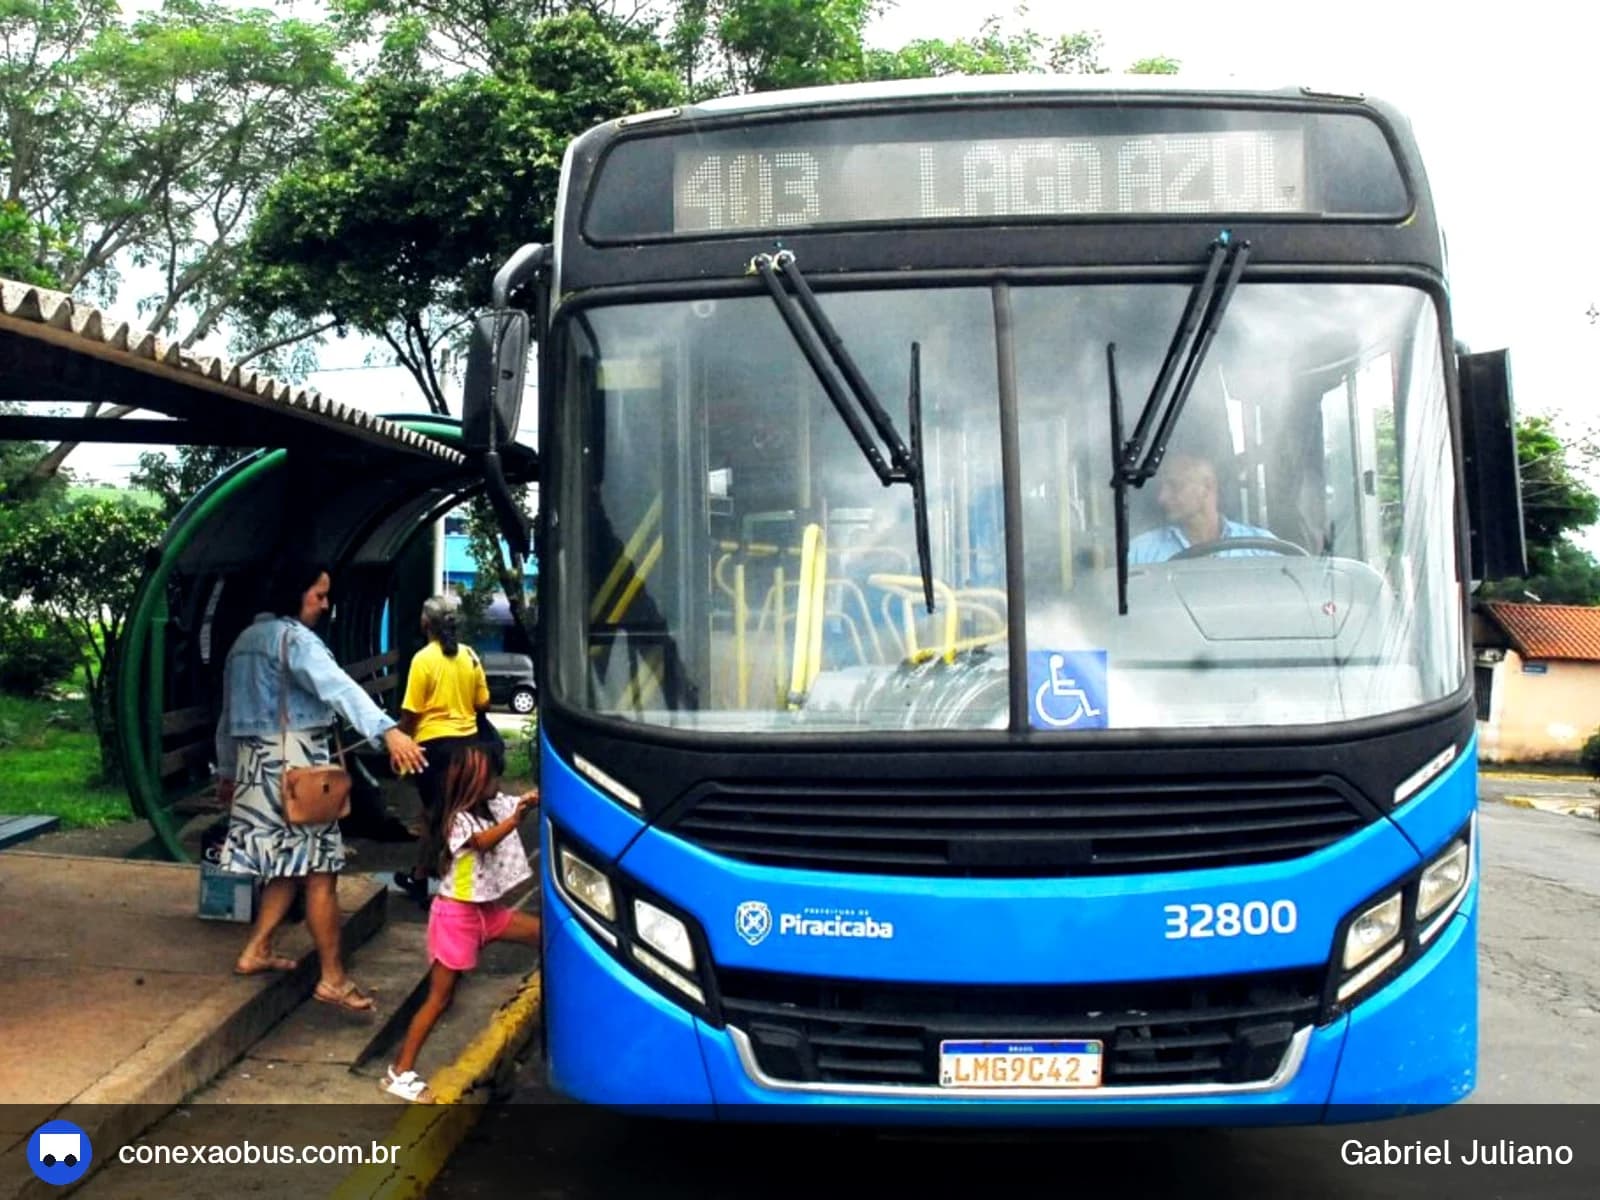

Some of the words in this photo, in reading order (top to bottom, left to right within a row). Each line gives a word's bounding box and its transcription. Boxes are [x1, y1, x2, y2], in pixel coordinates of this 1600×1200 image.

[919, 142, 1102, 217] LAGO
[1119, 133, 1302, 213] AZUL
[780, 913, 893, 938] Piracicaba
[1163, 900, 1297, 939] 32800
[954, 1056, 1081, 1082] LMG9C42
